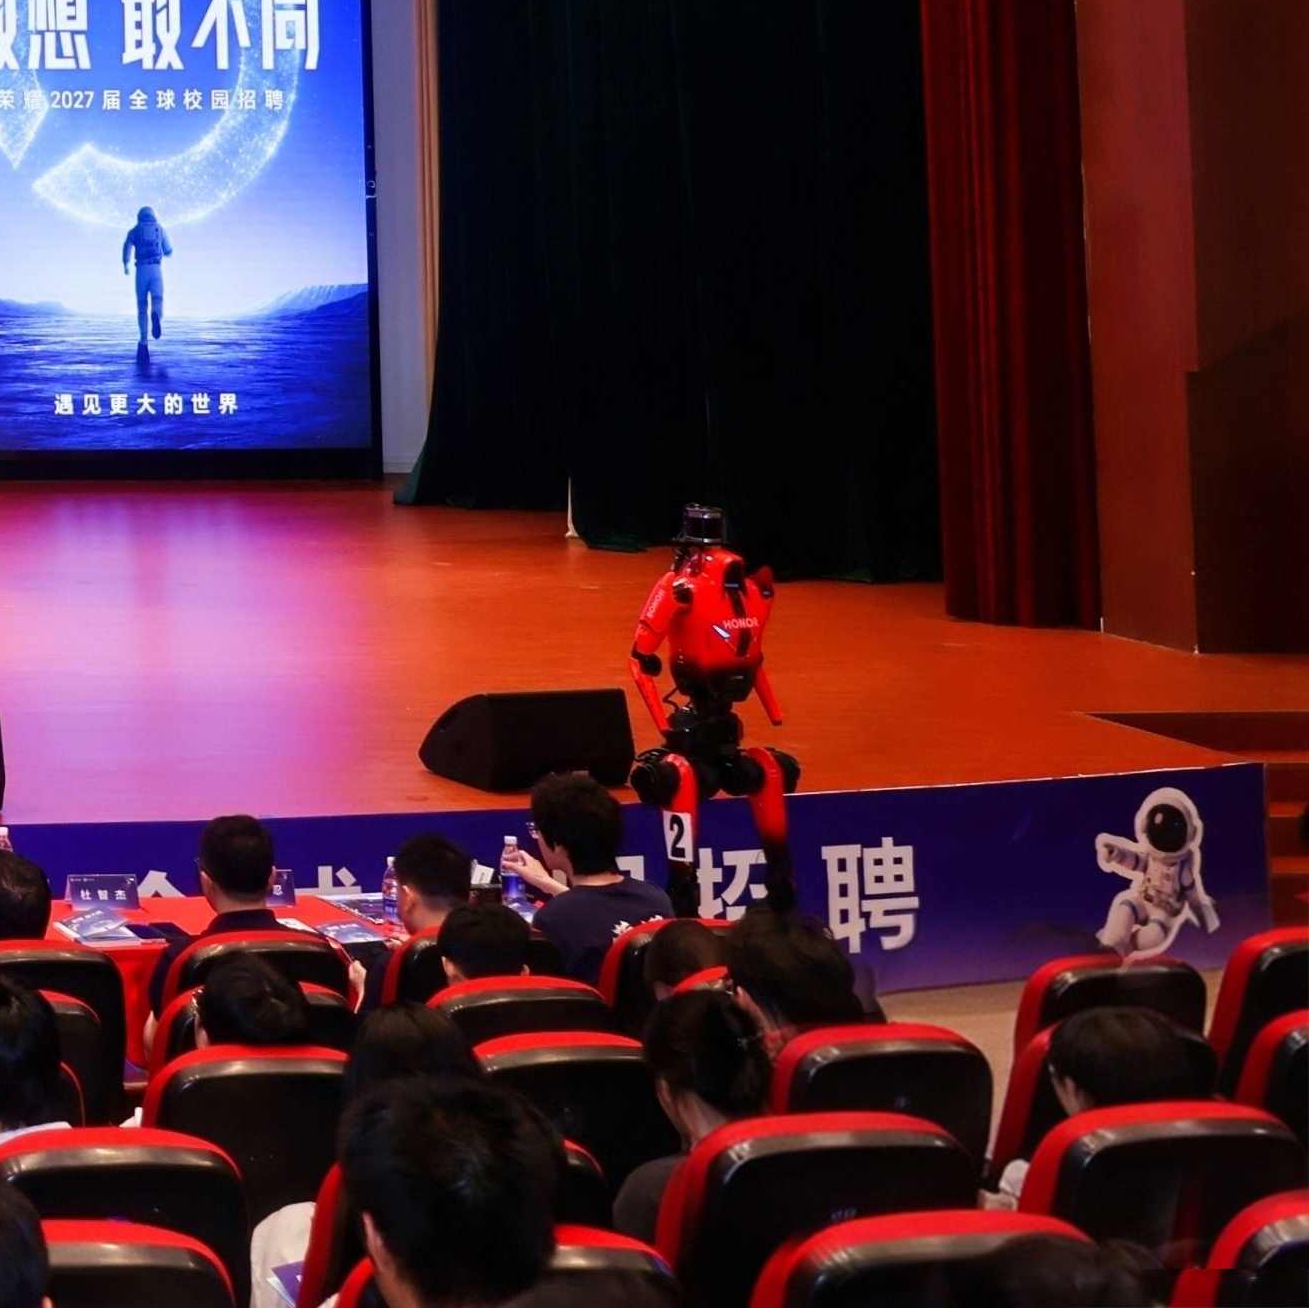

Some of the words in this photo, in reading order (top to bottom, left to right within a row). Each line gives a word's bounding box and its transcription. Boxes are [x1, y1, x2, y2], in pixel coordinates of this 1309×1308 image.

[54, 393, 238, 415] 遇见更大的世界
[722, 617, 759, 630] HONOR
[669, 813, 686, 859] 2
